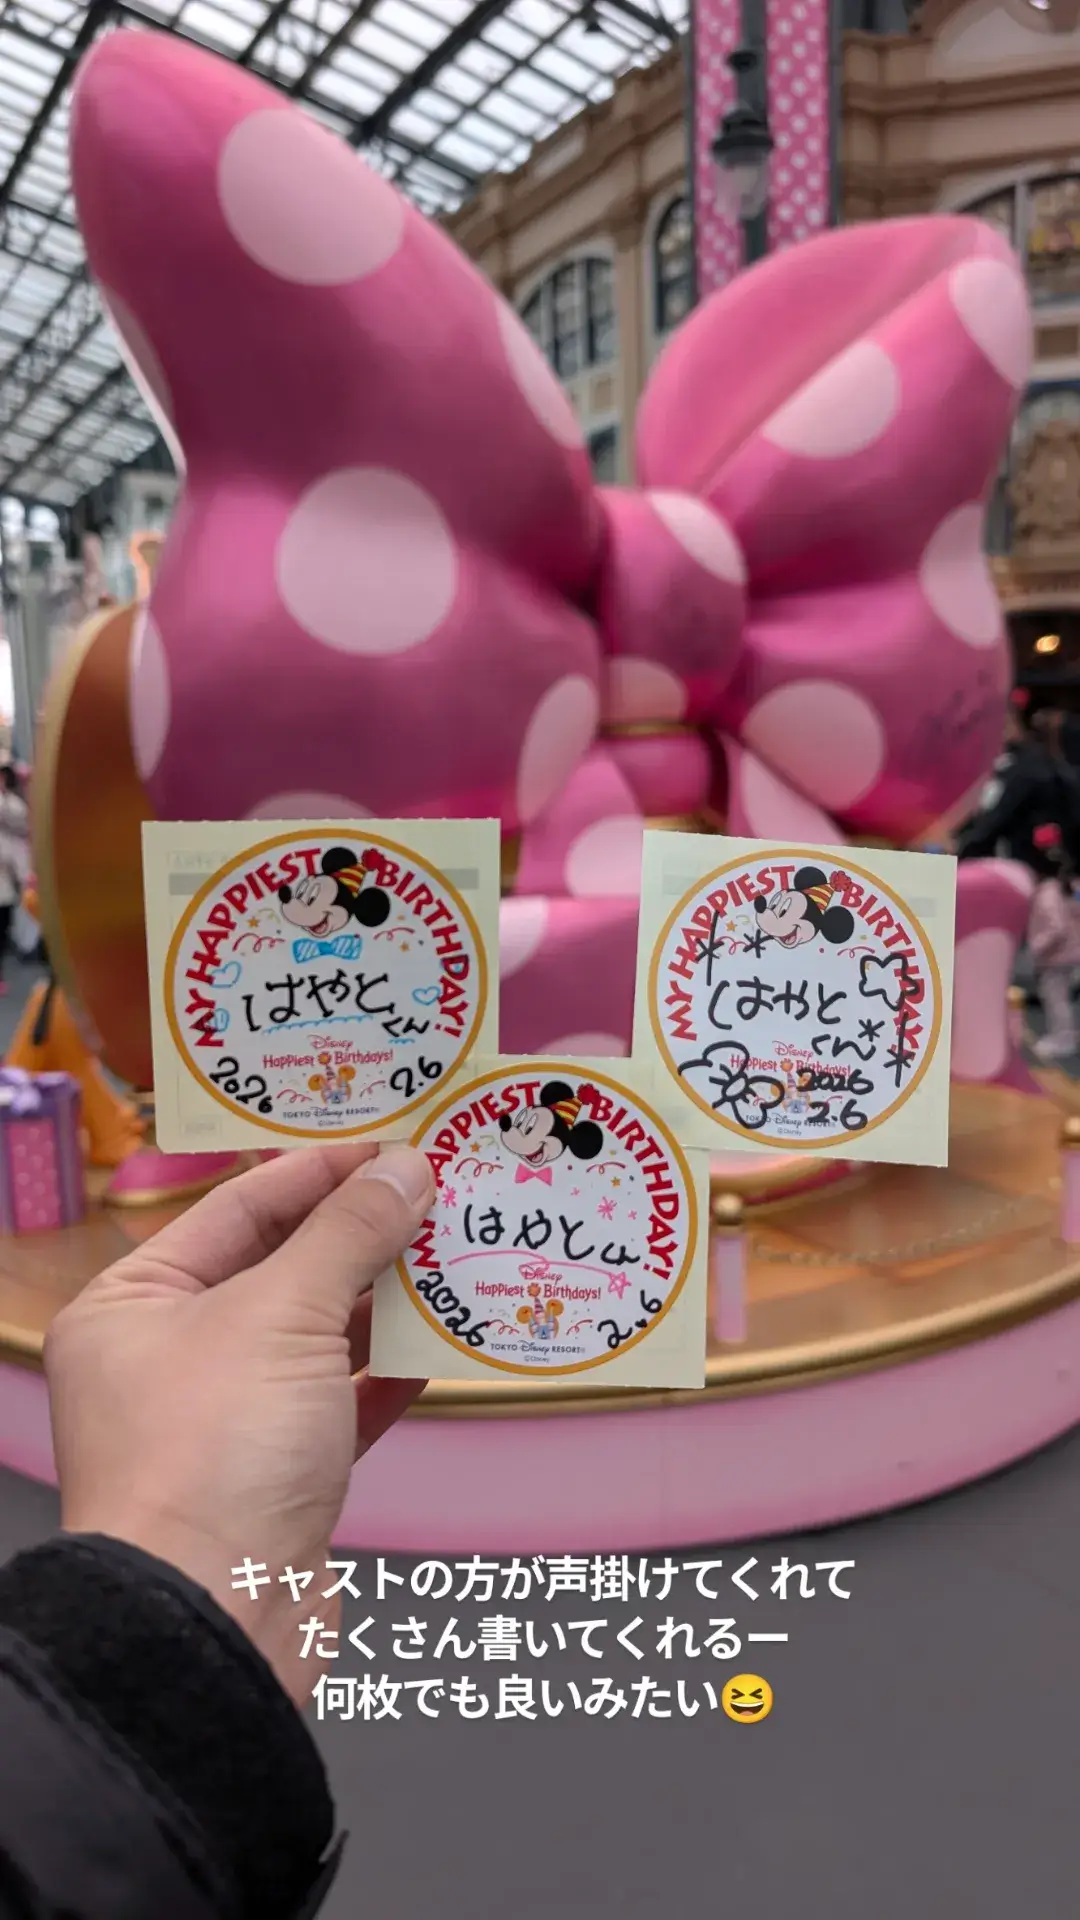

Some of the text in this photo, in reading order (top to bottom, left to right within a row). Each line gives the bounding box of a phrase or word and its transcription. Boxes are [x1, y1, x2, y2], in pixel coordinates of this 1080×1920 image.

[668, 865, 796, 980] HAPPIEST
[185, 848, 470, 1047] MY HAPPIEST BIRTHDAY!
[665, 980, 698, 1041] MY
[707, 976, 847, 1031] はやと
[263, 1048, 394, 1070] Happiest Birthdays!
[307, 1034, 353, 1051] Disney
[772, 1040, 814, 1061] Disney
[389, 1056, 443, 1097] 2.6
[730, 1053, 778, 1073] Happiest
[209, 1056, 273, 1113] 2026
[772, 1112, 802, 1128] Disney
[807, 1098, 868, 1131] 2.6
[425, 1081, 540, 1206] APPIEST
[589, 1098, 680, 1280] BIRTHDAY!
[416, 1271, 491, 1347] 2026
[475, 1280, 602, 1302] Happiest Birthdays!
[490, 1343, 518, 1351] TOKYO
[517, 1339, 550, 1355] Disney
